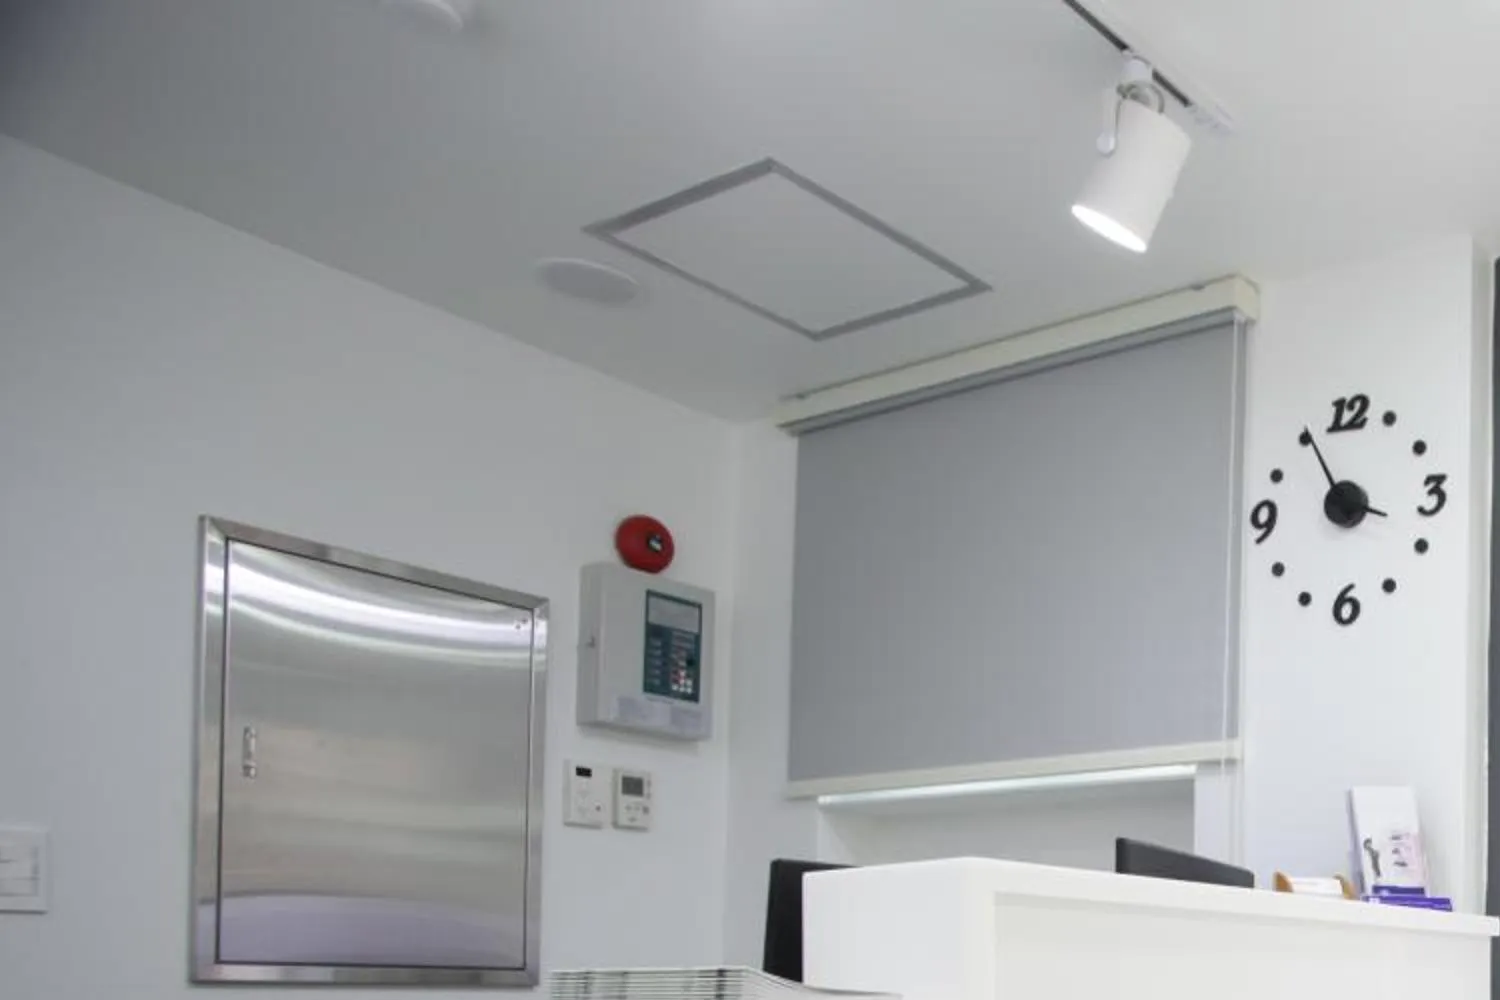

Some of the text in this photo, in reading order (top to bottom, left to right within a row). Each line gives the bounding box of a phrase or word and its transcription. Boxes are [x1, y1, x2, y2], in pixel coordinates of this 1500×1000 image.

[1325, 393, 1370, 433] 12
[1416, 473, 1447, 517] 3
[1249, 499, 1278, 545] 9
[1331, 583, 1361, 627] 6
